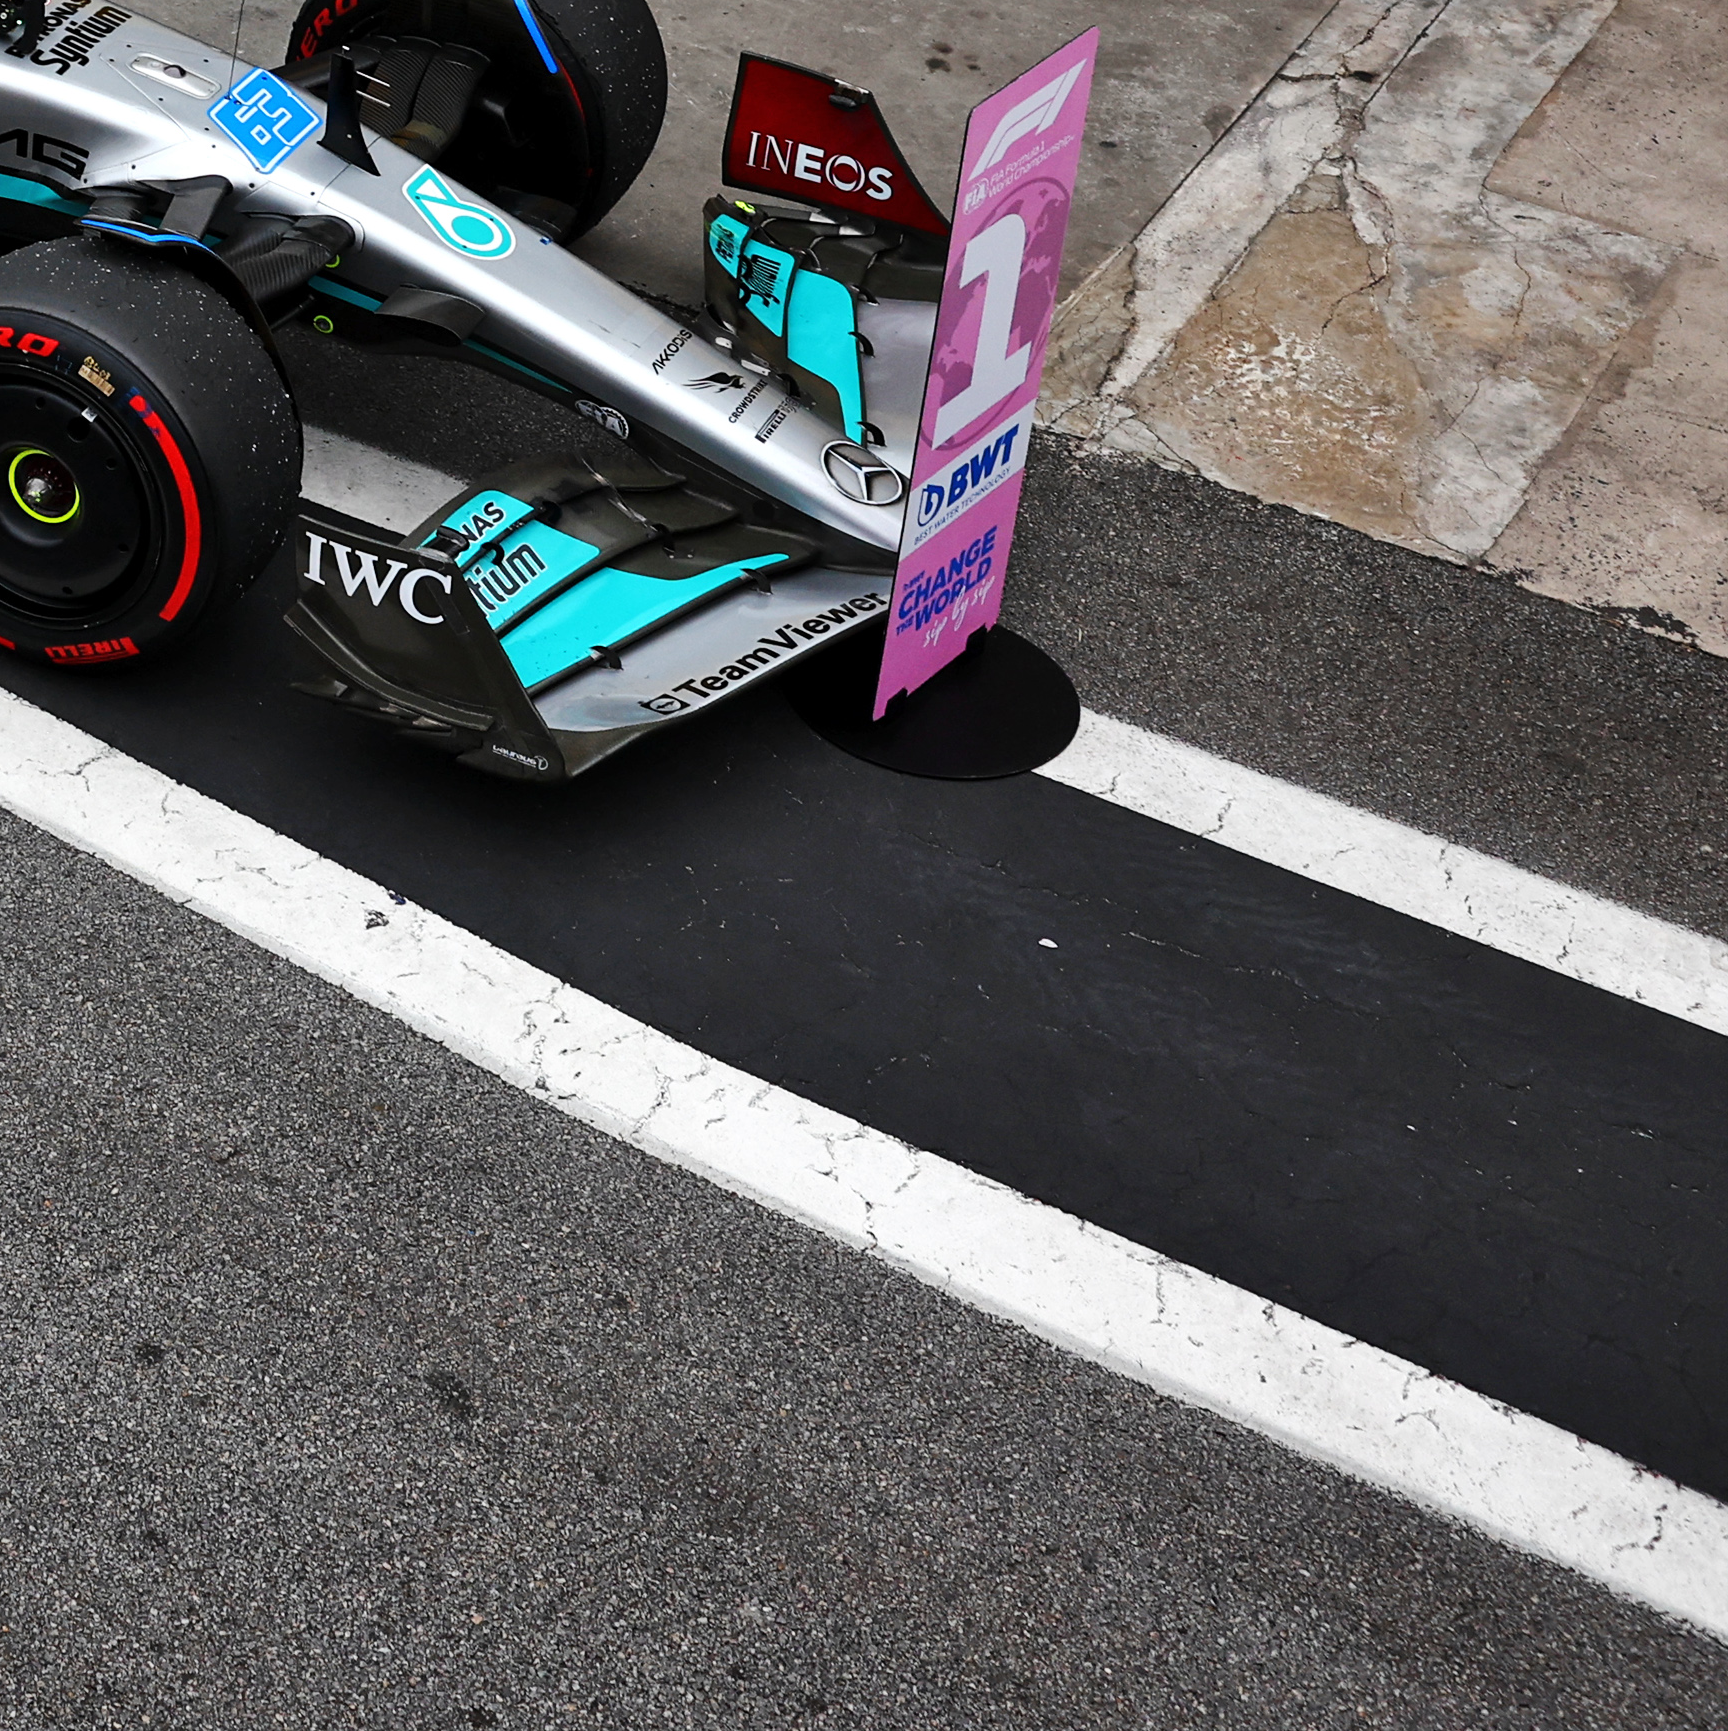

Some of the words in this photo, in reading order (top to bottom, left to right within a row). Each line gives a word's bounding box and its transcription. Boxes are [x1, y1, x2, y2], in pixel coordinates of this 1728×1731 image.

[31, 3, 133, 76] Syntium
[745, 130, 894, 202] INEOS
[990, 168, 1006, 184] FIA
[1006, 150, 1040, 174] Formula
[1040, 141, 1045, 151] 1
[933, 213, 1033, 452] 1
[728, 378, 768, 424] CROWDSTRIKE
[754, 409, 787, 444] PIRELLI
[947, 423, 1019, 508] BWT
[915, 526, 932, 546] BEST
[934, 506, 960, 531] WATER
[961, 467, 1011, 512] TECHNOLOGY
[304, 531, 452, 624] IWC
[896, 616, 915, 636] THE
[914, 556, 992, 632] WORLD
[898, 526, 997, 620] CHANGE
[671, 590, 890, 704] TeamViewer
[924, 617, 947, 648] sip
[952, 586, 968, 631] by
[971, 575, 995, 606] sip
[45, 637, 140, 664] PIRELLI
